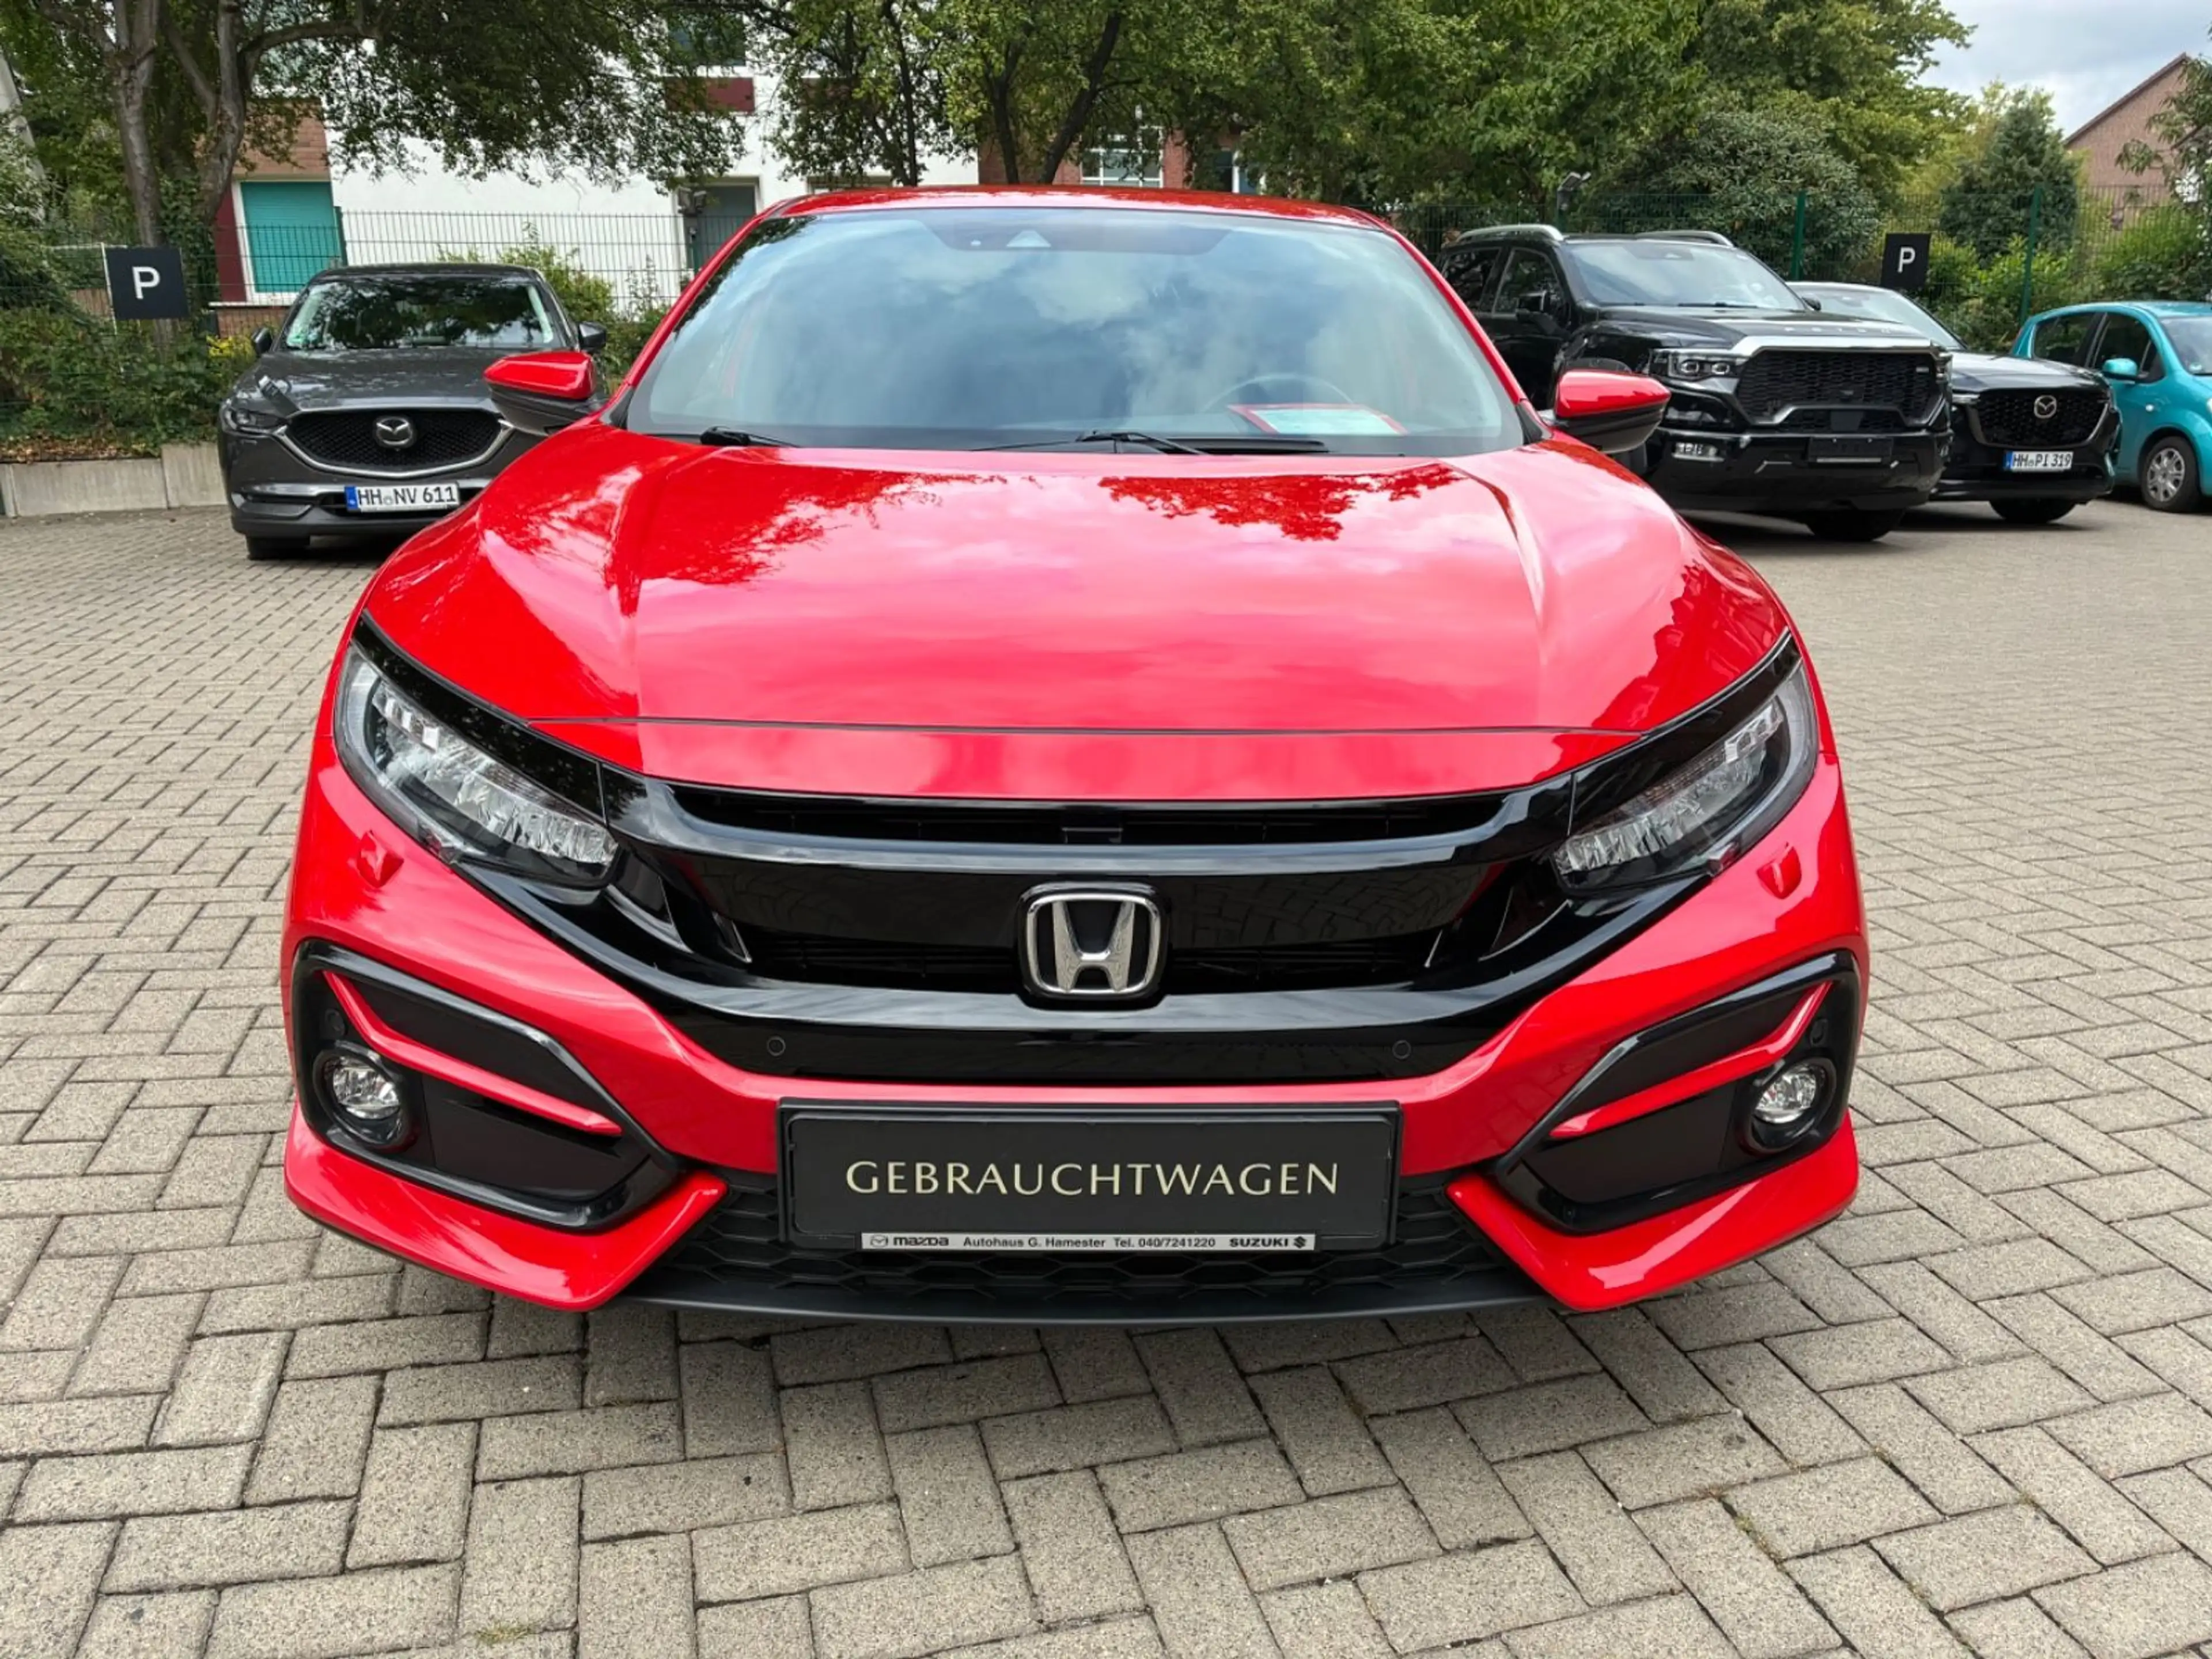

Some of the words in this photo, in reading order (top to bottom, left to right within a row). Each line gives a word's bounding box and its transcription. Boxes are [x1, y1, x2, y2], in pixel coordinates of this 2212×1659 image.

[1897, 247, 1916, 274] P
[132, 266, 161, 300] P
[2012, 453, 2029, 467] HH
[2035, 453, 2048, 467] PI
[2051, 453, 2072, 467] 319
[358, 488, 382, 505] HH
[393, 487, 416, 505] NV
[423, 486, 457, 504] 611
[846, 1160, 1338, 1196] GEBRAUCHTWAGEN
[893, 1236, 949, 1247] mazda
[963, 1237, 1024, 1247] Autohaus
[1028, 1237, 1041, 1248] G.
[1045, 1237, 1105, 1248] Hamester
[1113, 1237, 1135, 1248] Tel.
[1138, 1237, 1216, 1248] 040/7241220
[1229, 1237, 1289, 1248] SUZUKI
